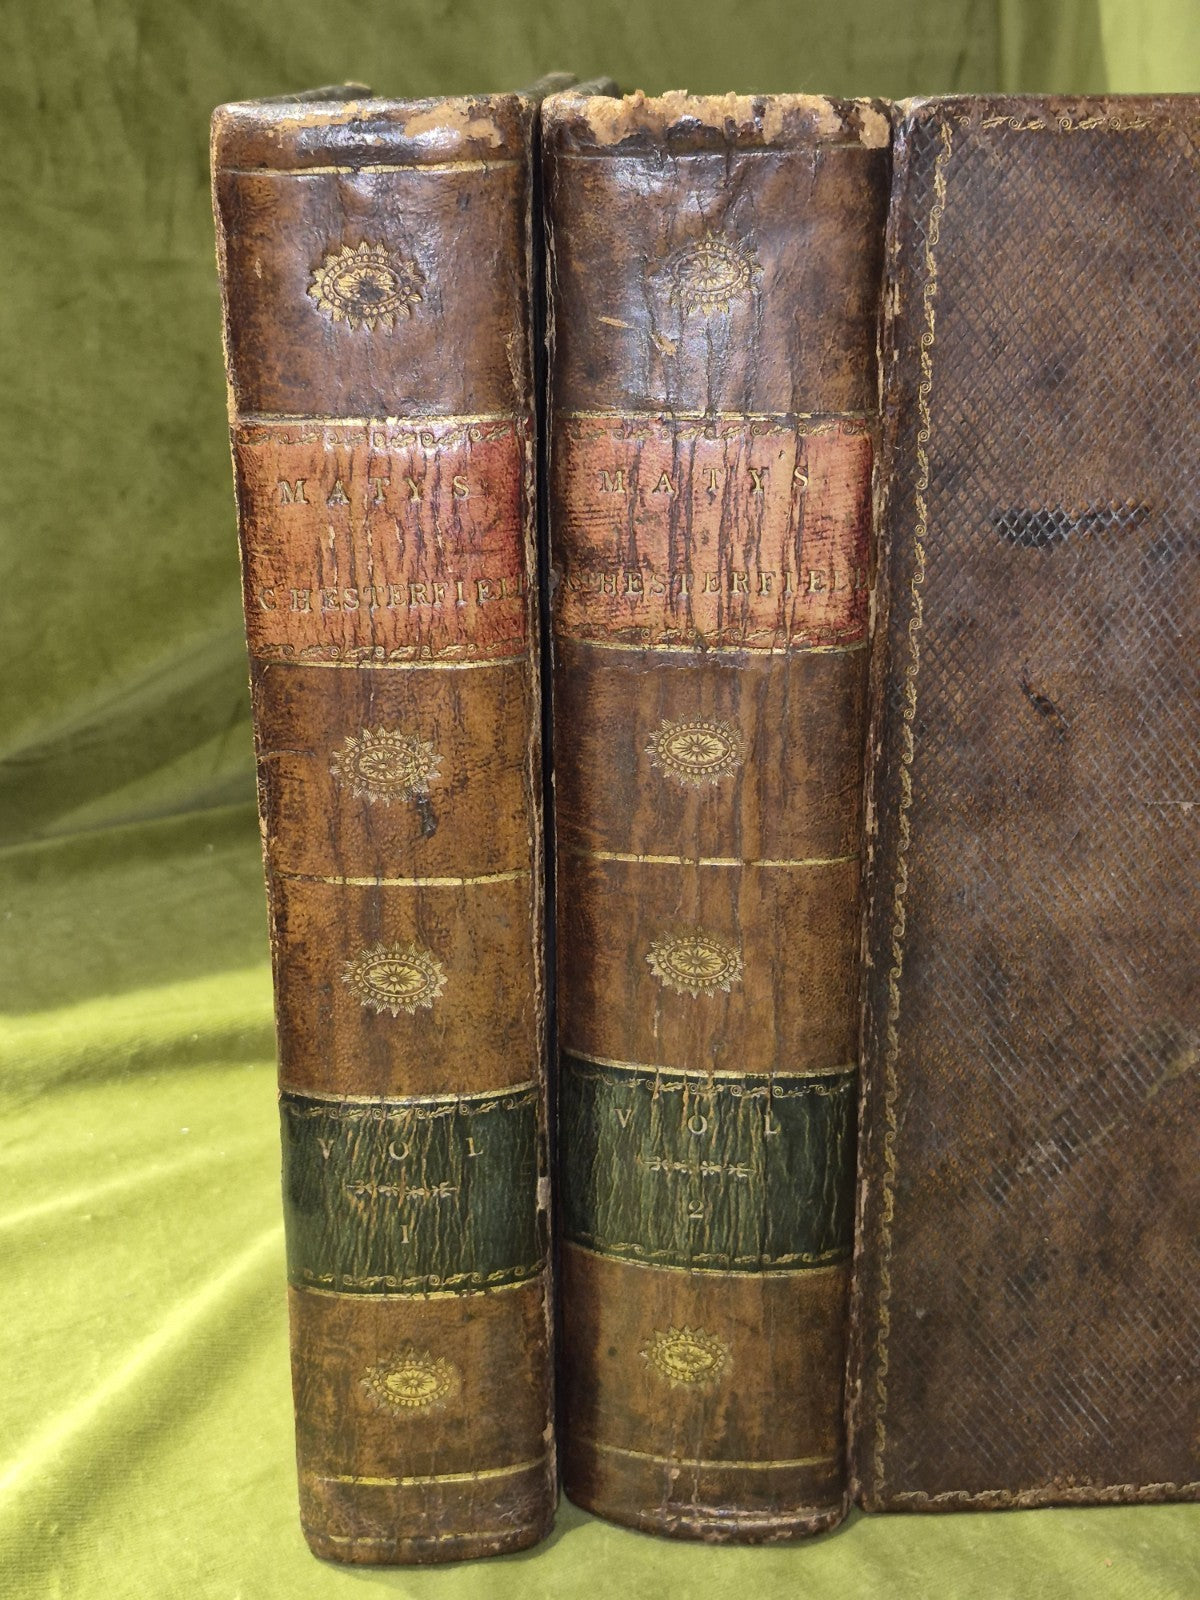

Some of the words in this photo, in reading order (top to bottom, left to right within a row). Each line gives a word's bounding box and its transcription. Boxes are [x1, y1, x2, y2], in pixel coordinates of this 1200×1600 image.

[276, 474, 472, 505] MATYS
[600, 465, 810, 495] MATYS
[614, 1108, 782, 1136] VOL
[317, 1136, 484, 1161] VOL
[687, 1199, 705, 1219] 2
